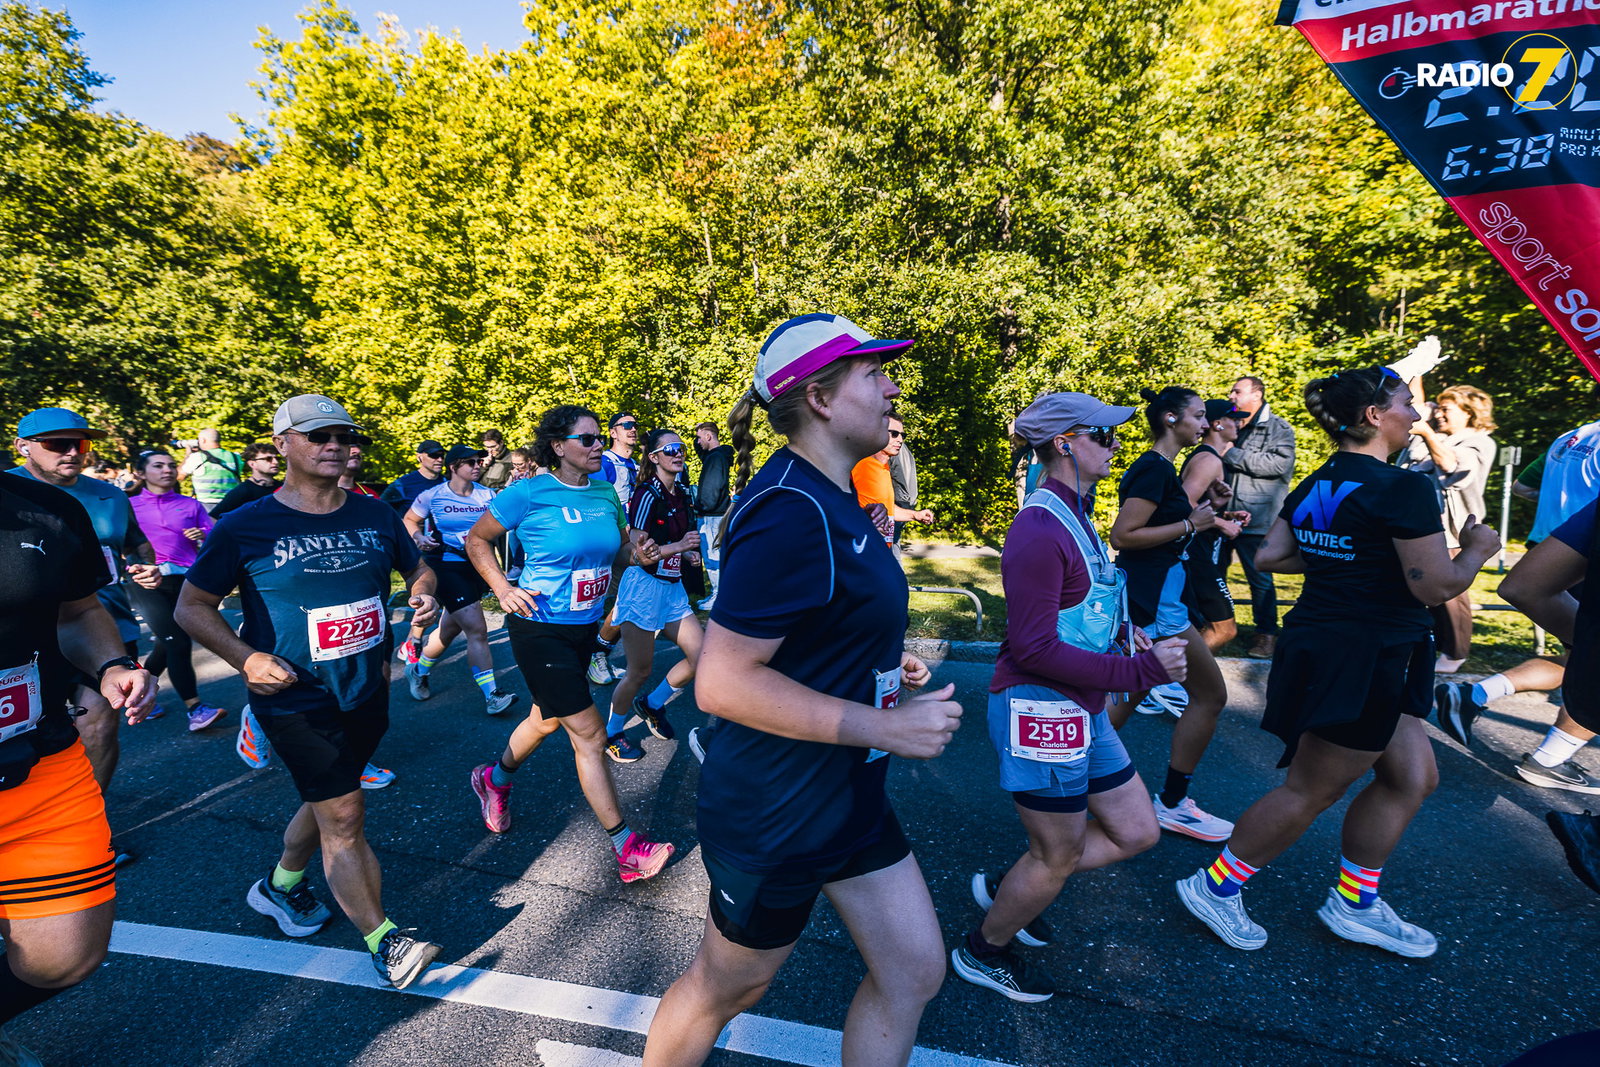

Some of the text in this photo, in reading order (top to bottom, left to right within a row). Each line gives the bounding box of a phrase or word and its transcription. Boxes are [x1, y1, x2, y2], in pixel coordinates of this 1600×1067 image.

[1441, 133, 1555, 181] 6:38
[1560, 142, 1586, 156] PRO
[1480, 202, 1573, 291] sport
[444, 505, 488, 513] Oberbank
[273, 534, 356, 569] SANTA
[357, 530, 385, 552] FE
[356, 602, 378, 613] beurer
[327, 617, 374, 642] 2222
[342, 636, 365, 645] Philippe
[1060, 706, 1082, 715] beurer
[1028, 722, 1078, 742] 2519
